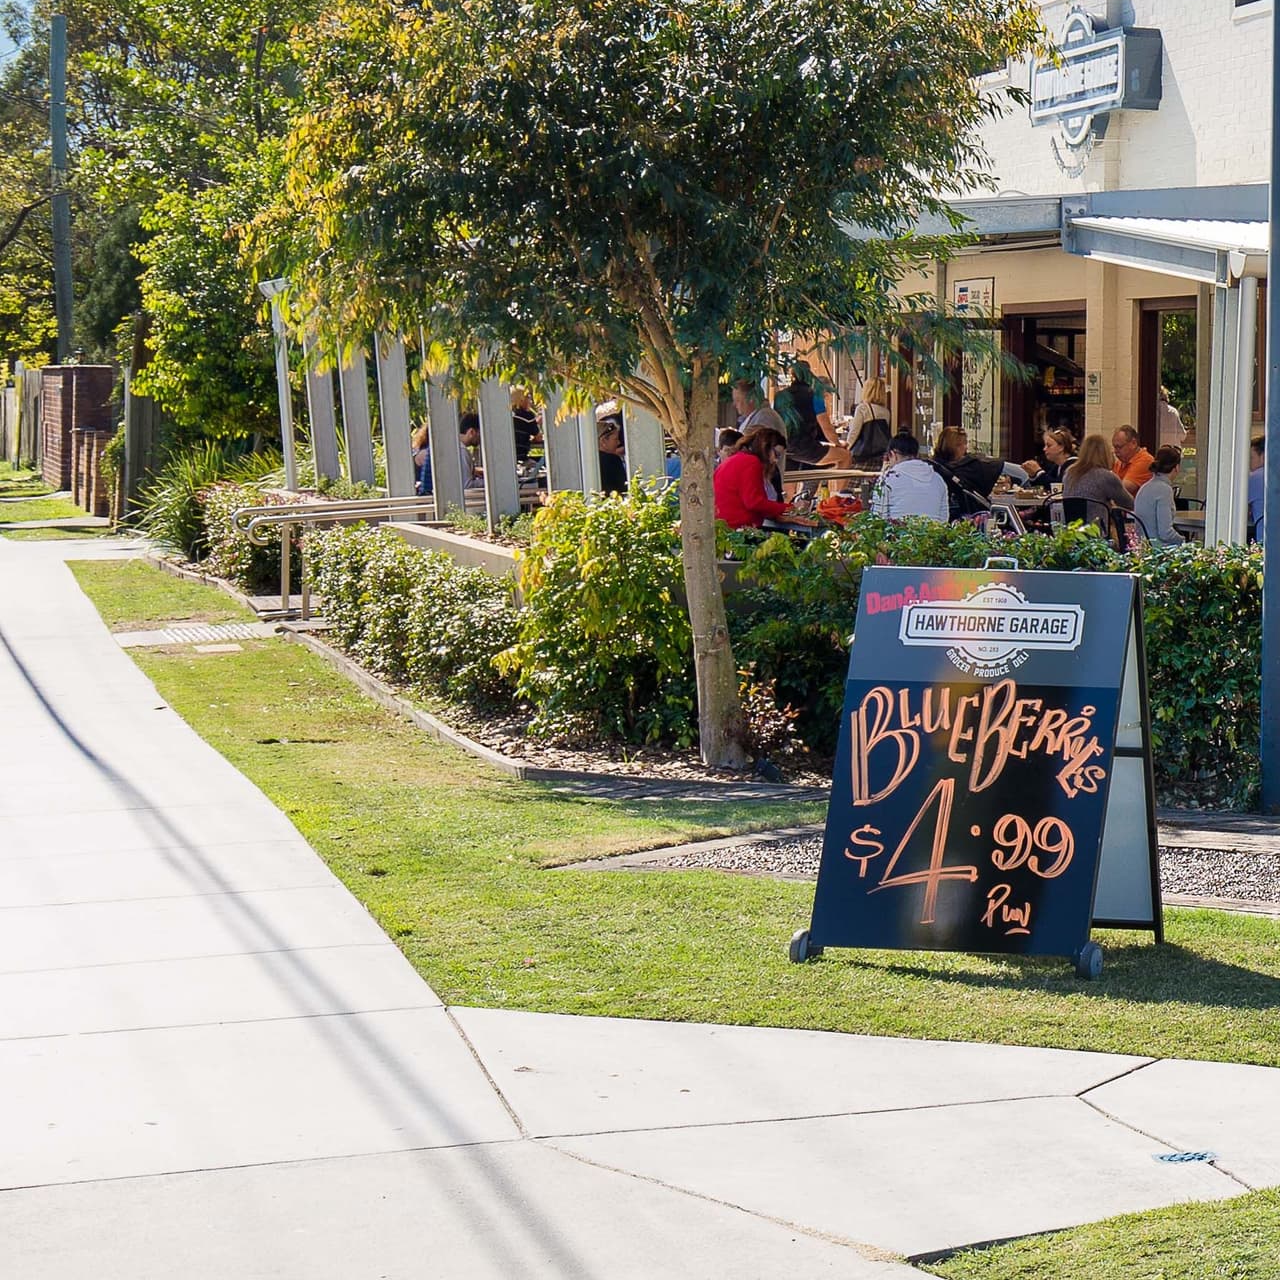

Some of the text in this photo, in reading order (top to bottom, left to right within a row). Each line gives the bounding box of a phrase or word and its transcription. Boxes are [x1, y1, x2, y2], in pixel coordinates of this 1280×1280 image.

[914, 614, 1069, 635] HAWTHORNE GARAGE
[945, 648, 1030, 679] GROCER PRODUCE DELI
